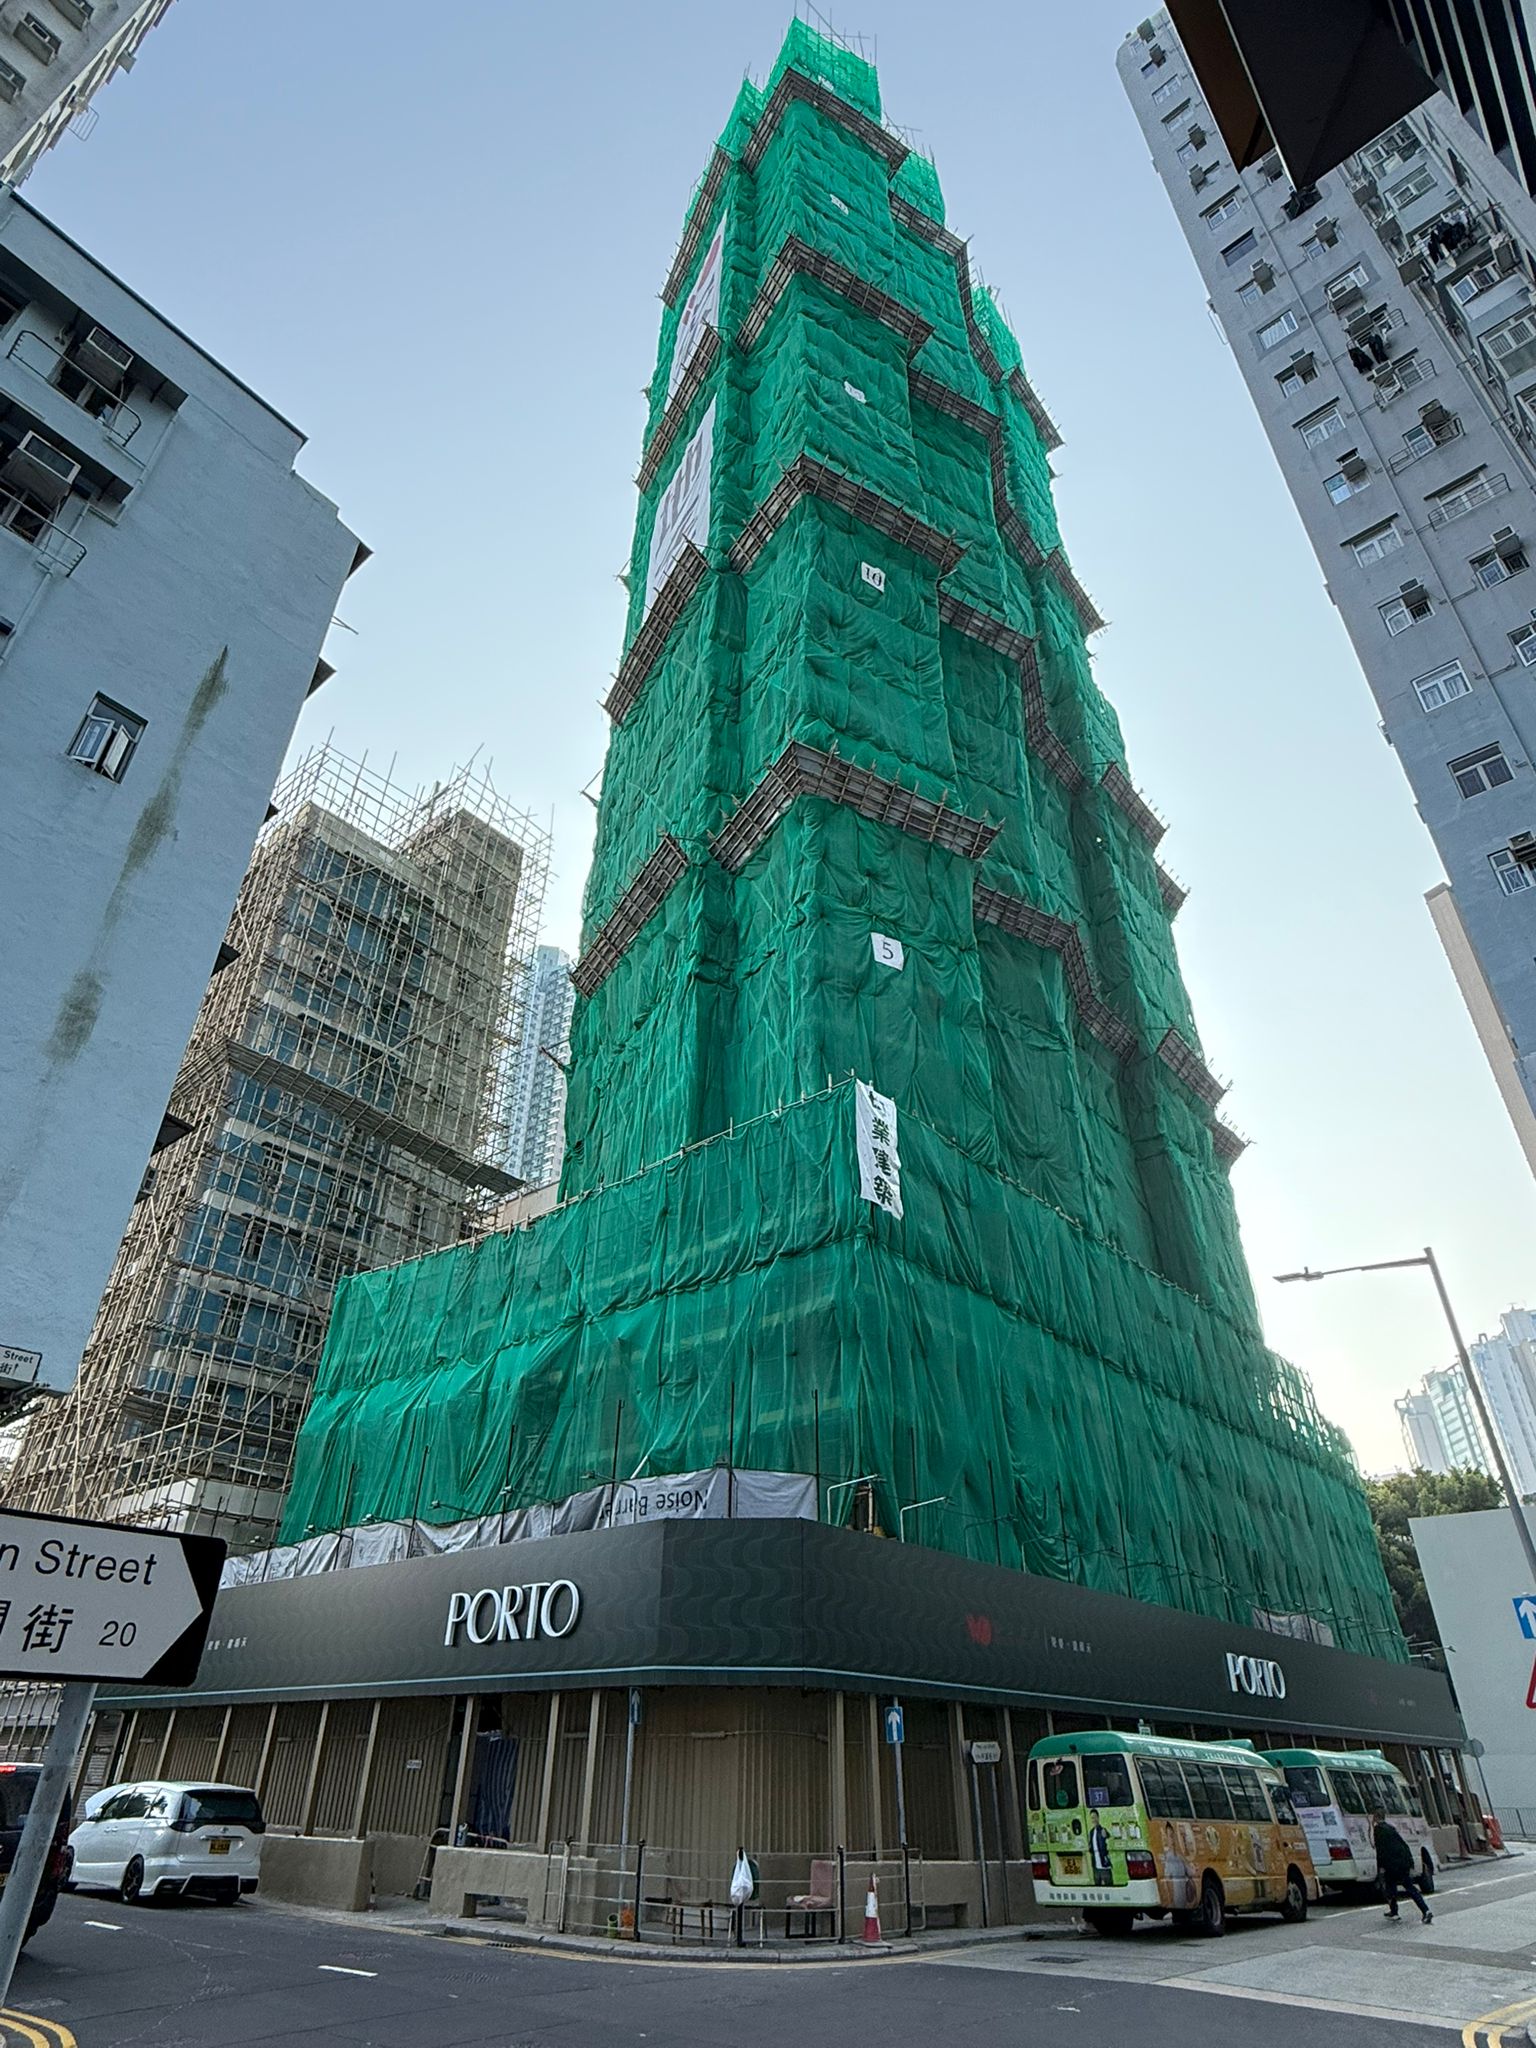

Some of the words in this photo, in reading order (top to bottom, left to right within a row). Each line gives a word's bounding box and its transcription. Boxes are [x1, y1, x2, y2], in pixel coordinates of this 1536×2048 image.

[866, 566, 882, 587] 10
[882, 940, 894, 960] 5
[3, 1350, 34, 1364] Street
[656, 1489, 708, 1512] Noise
[35, 1539, 157, 1585] Street
[444, 1579, 580, 1646] PORTO
[98, 1620, 137, 1647] 20
[1225, 1652, 1286, 1700] PORTO
